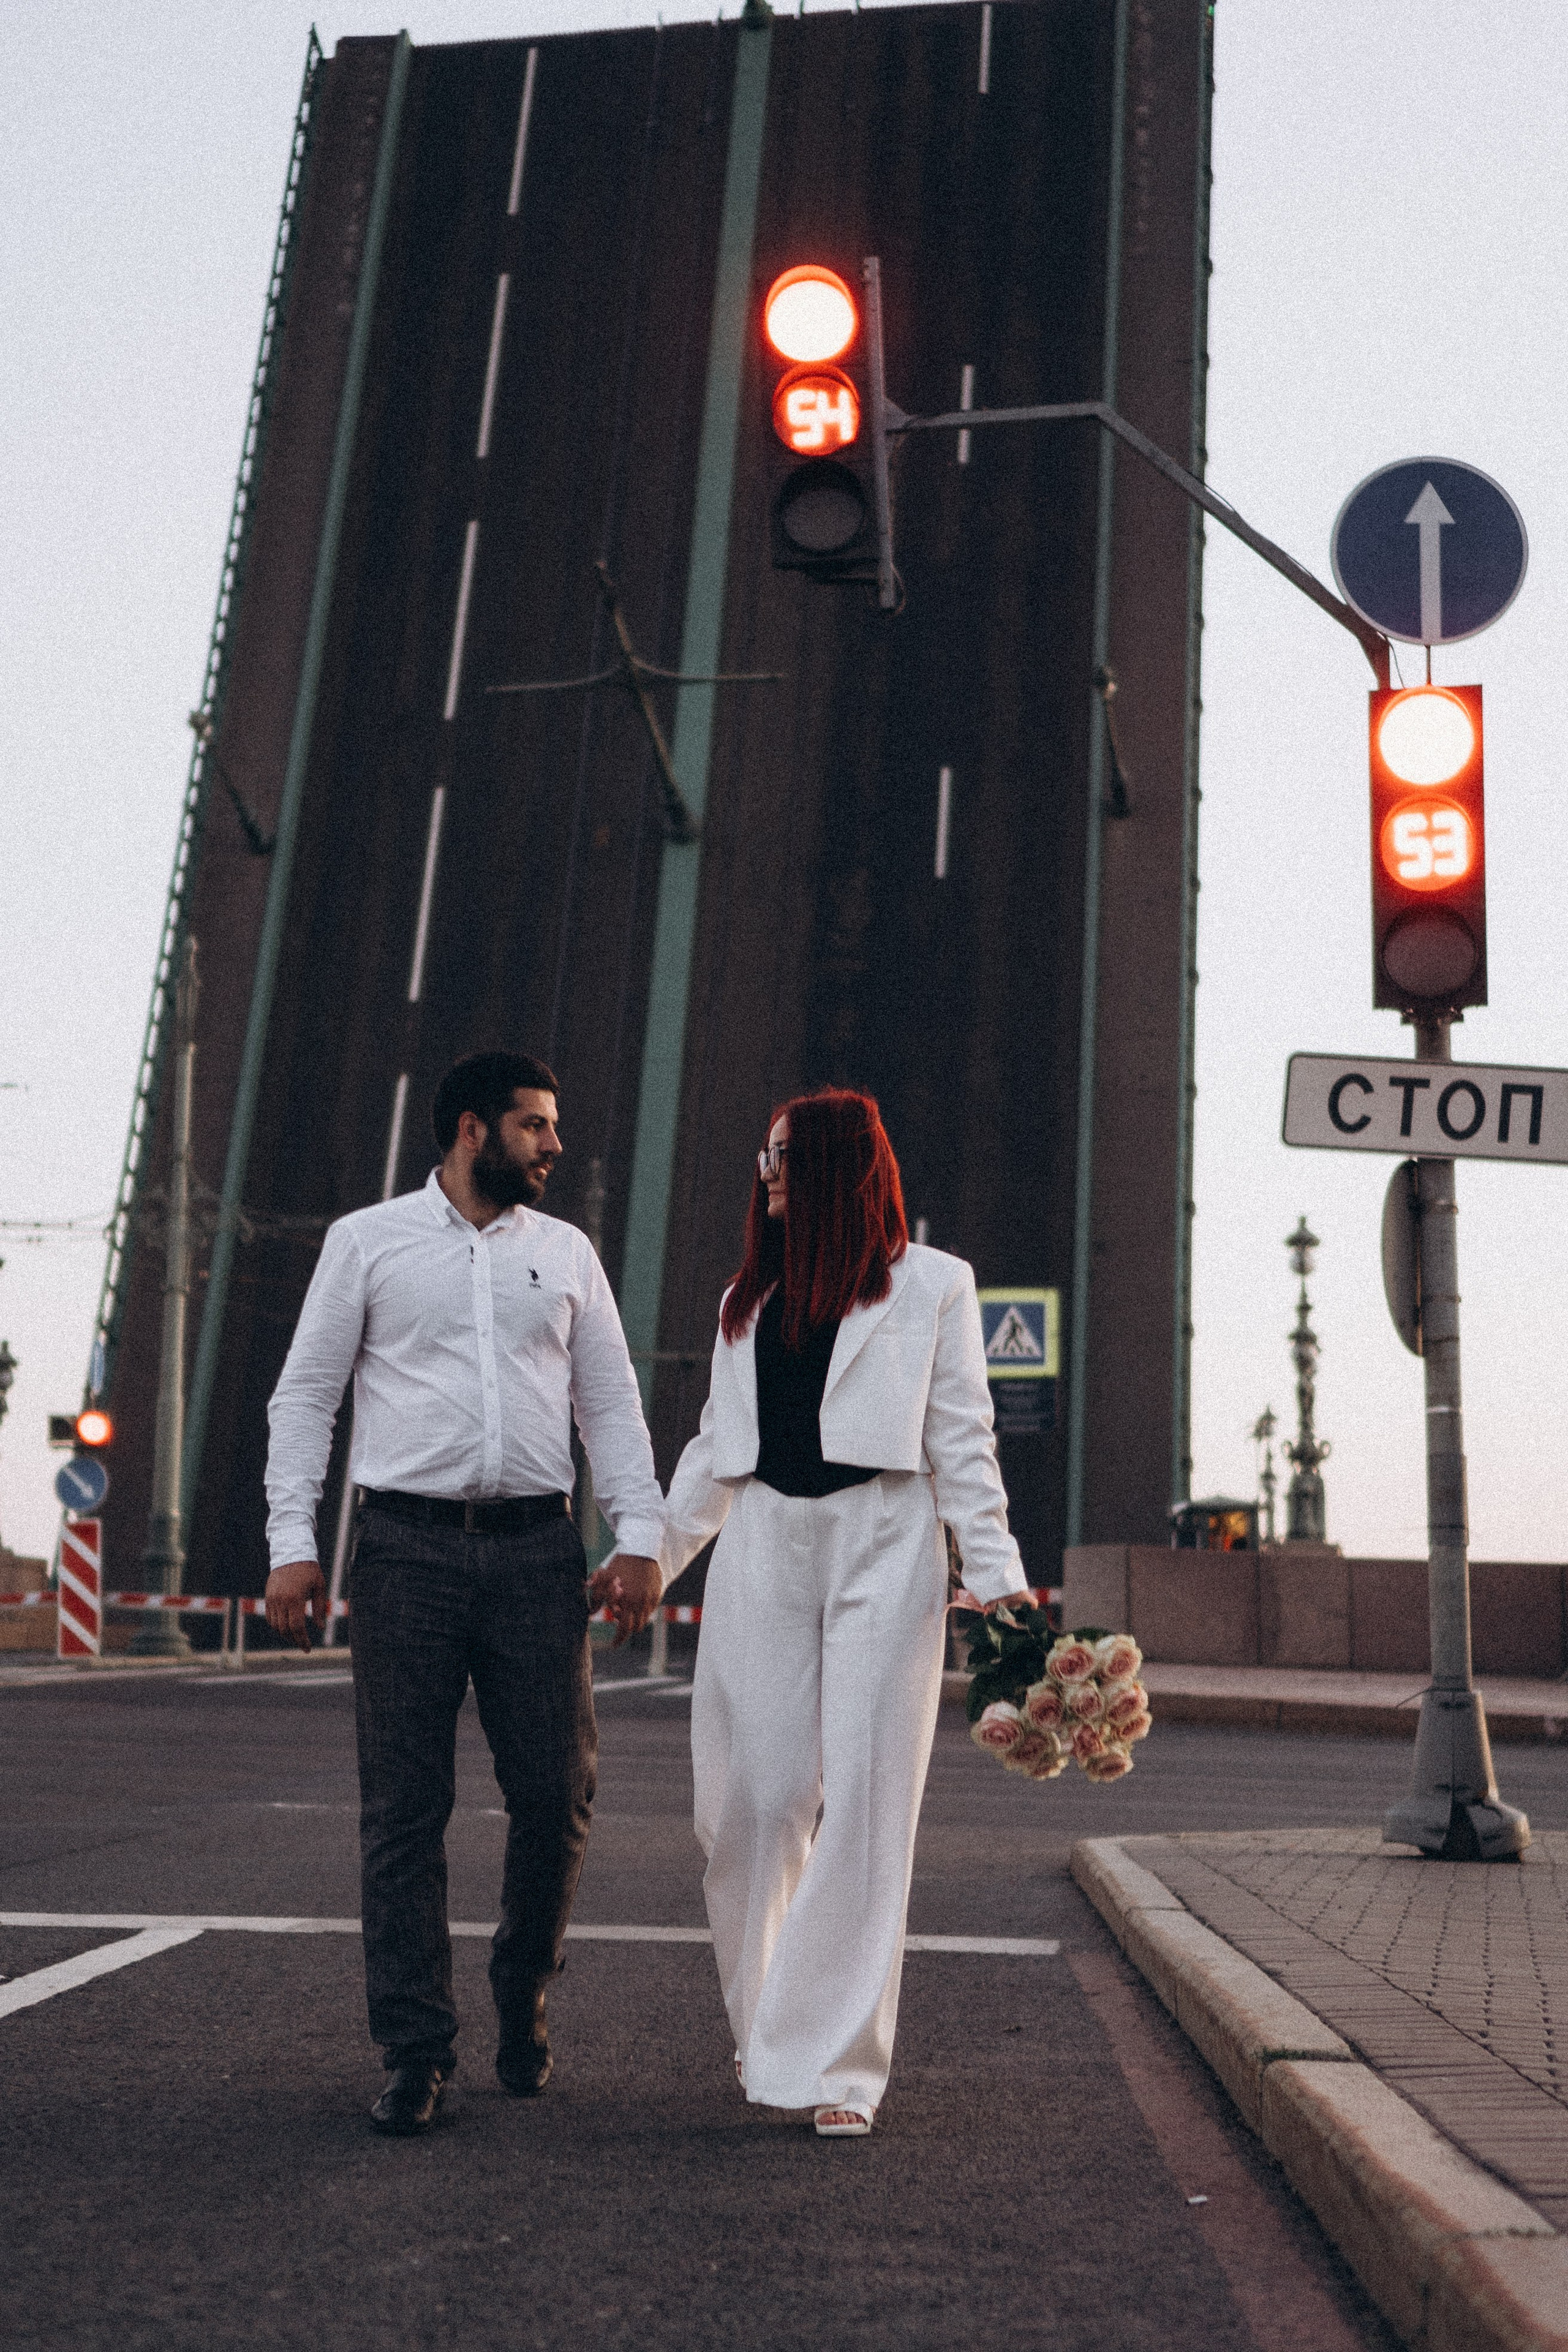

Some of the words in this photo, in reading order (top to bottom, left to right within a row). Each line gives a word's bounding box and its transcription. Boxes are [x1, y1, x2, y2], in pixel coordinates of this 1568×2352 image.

[786, 388, 854, 447] 54
[1392, 809, 1469, 880] 53
[1327, 1072, 1545, 1145] СТОП
